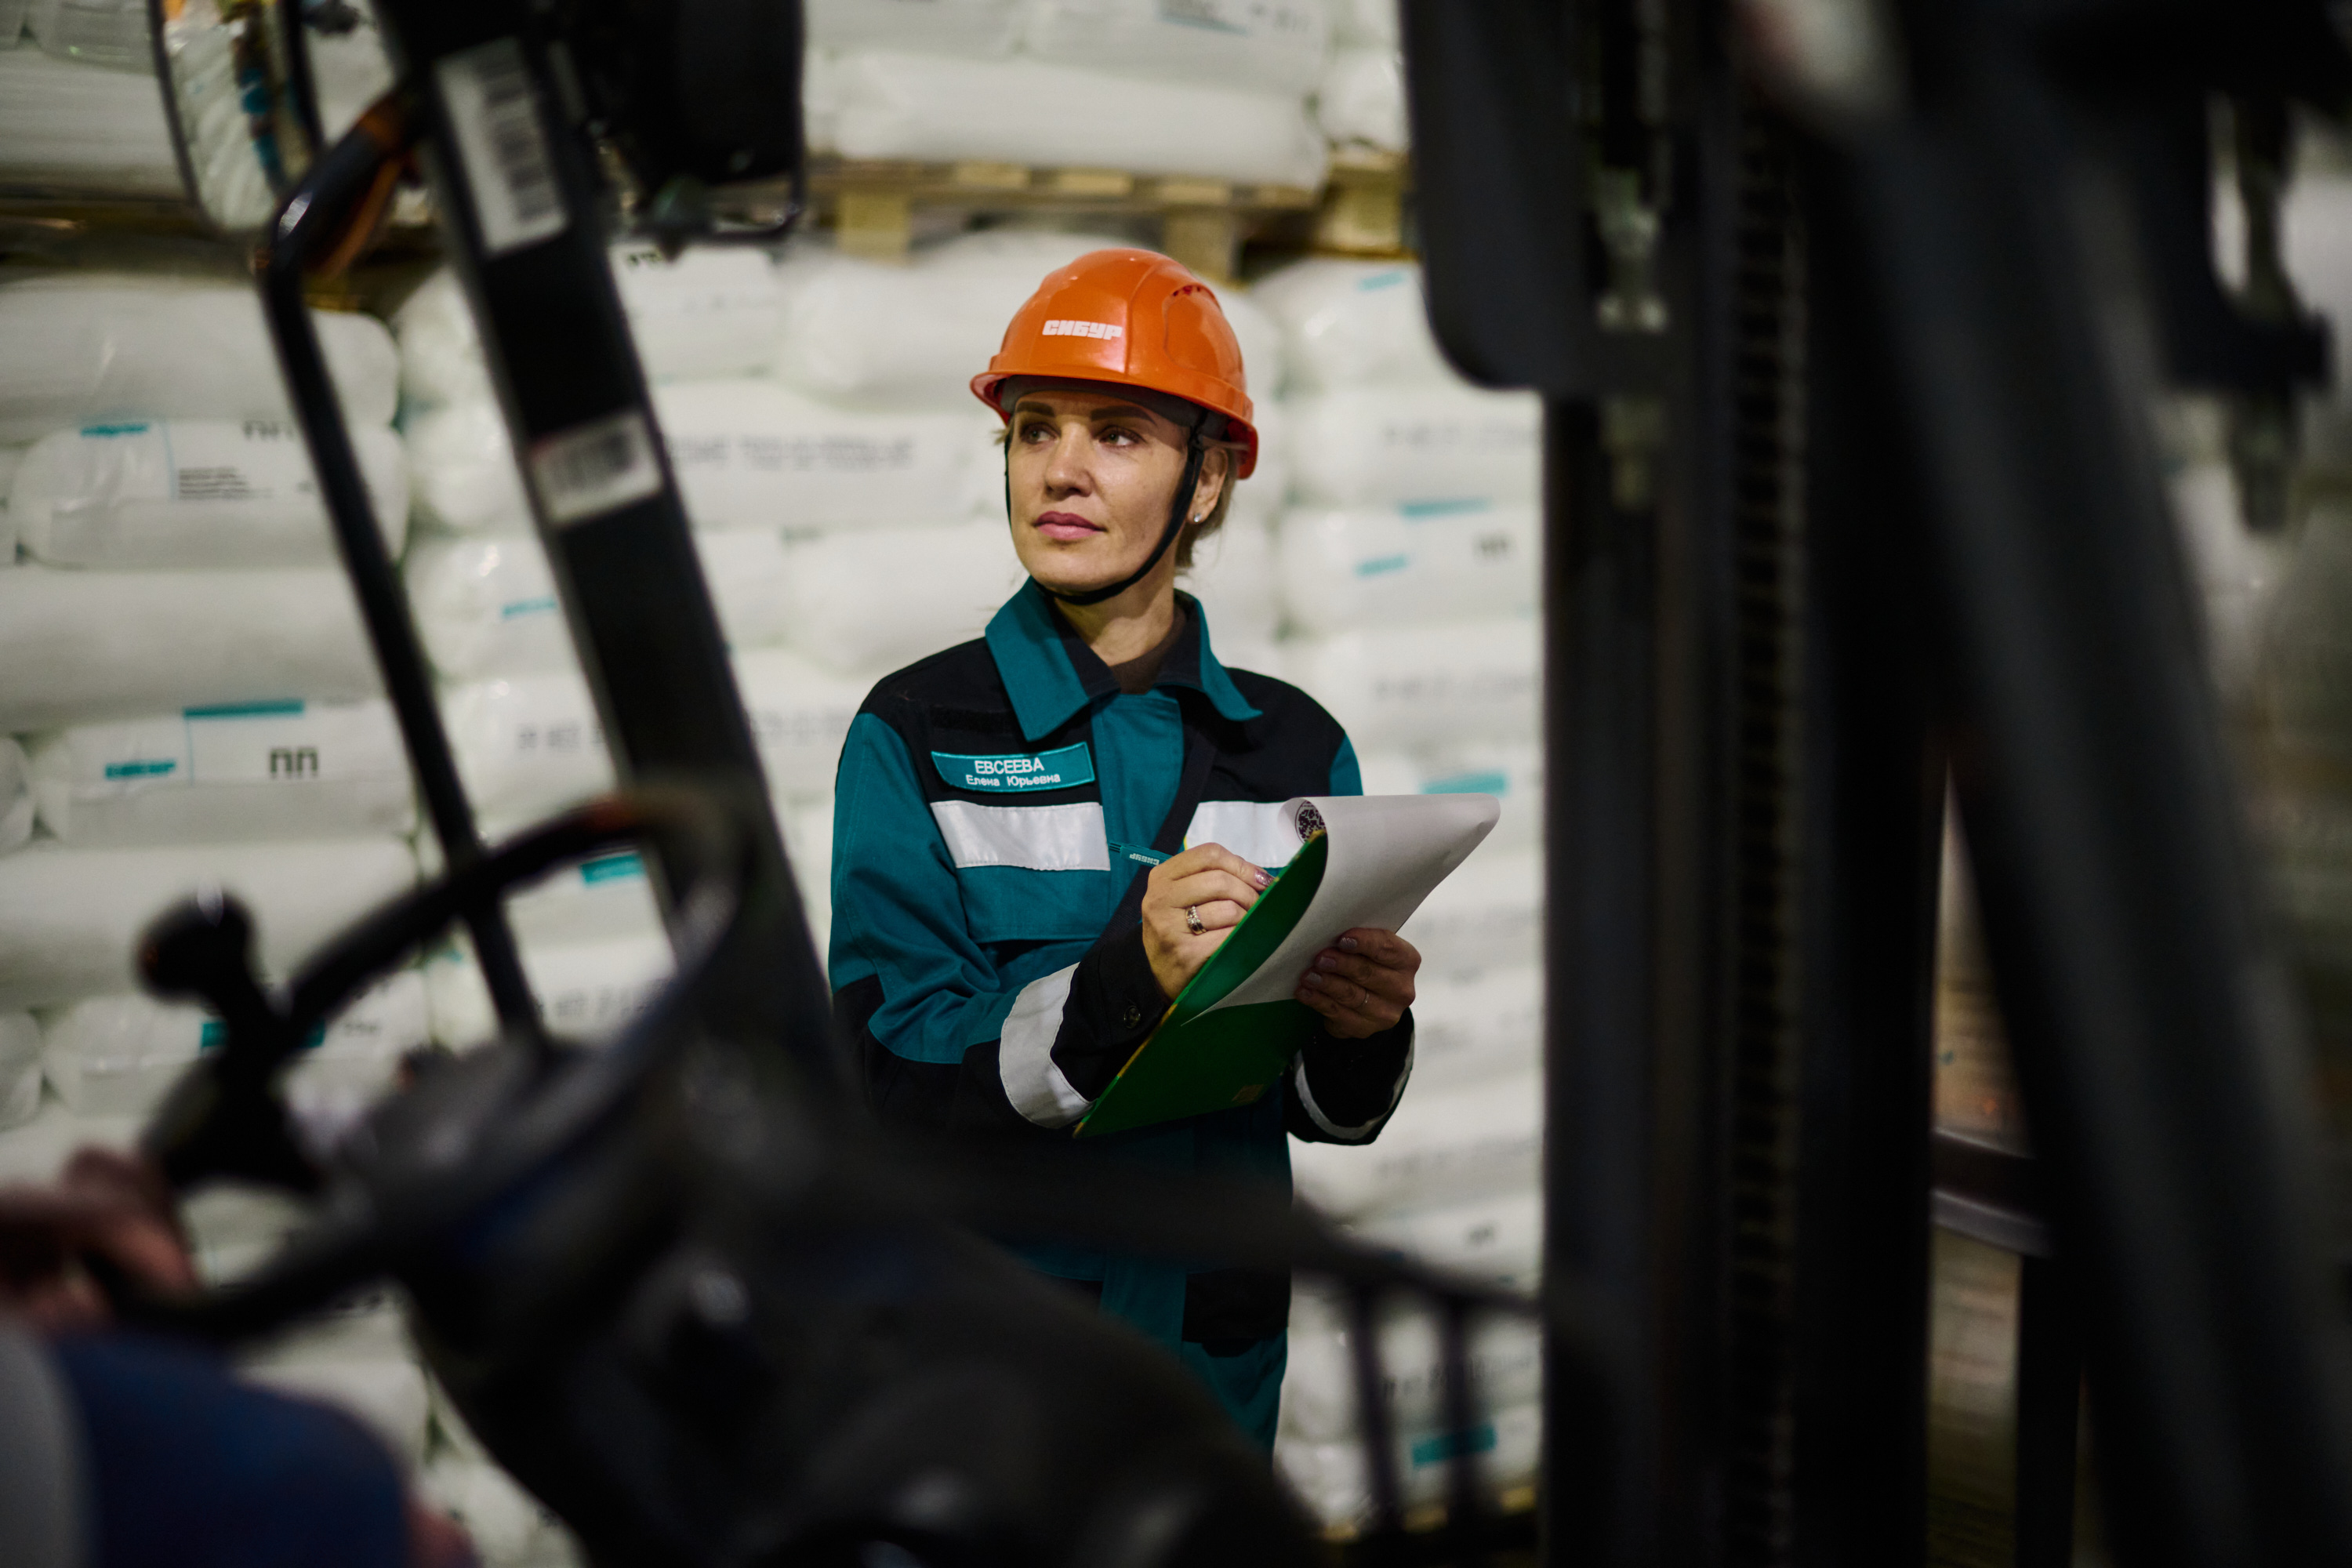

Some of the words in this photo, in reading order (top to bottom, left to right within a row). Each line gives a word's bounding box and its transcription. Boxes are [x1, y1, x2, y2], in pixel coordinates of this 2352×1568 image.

[1042, 320, 1123, 340] СИБУР
[975, 757, 1044, 774] ЕВСЕЕВА
[966, 775, 1000, 786] Елена
[1007, 774, 1061, 788] Юрьевна
[1129, 852, 1160, 866] СИБУР
